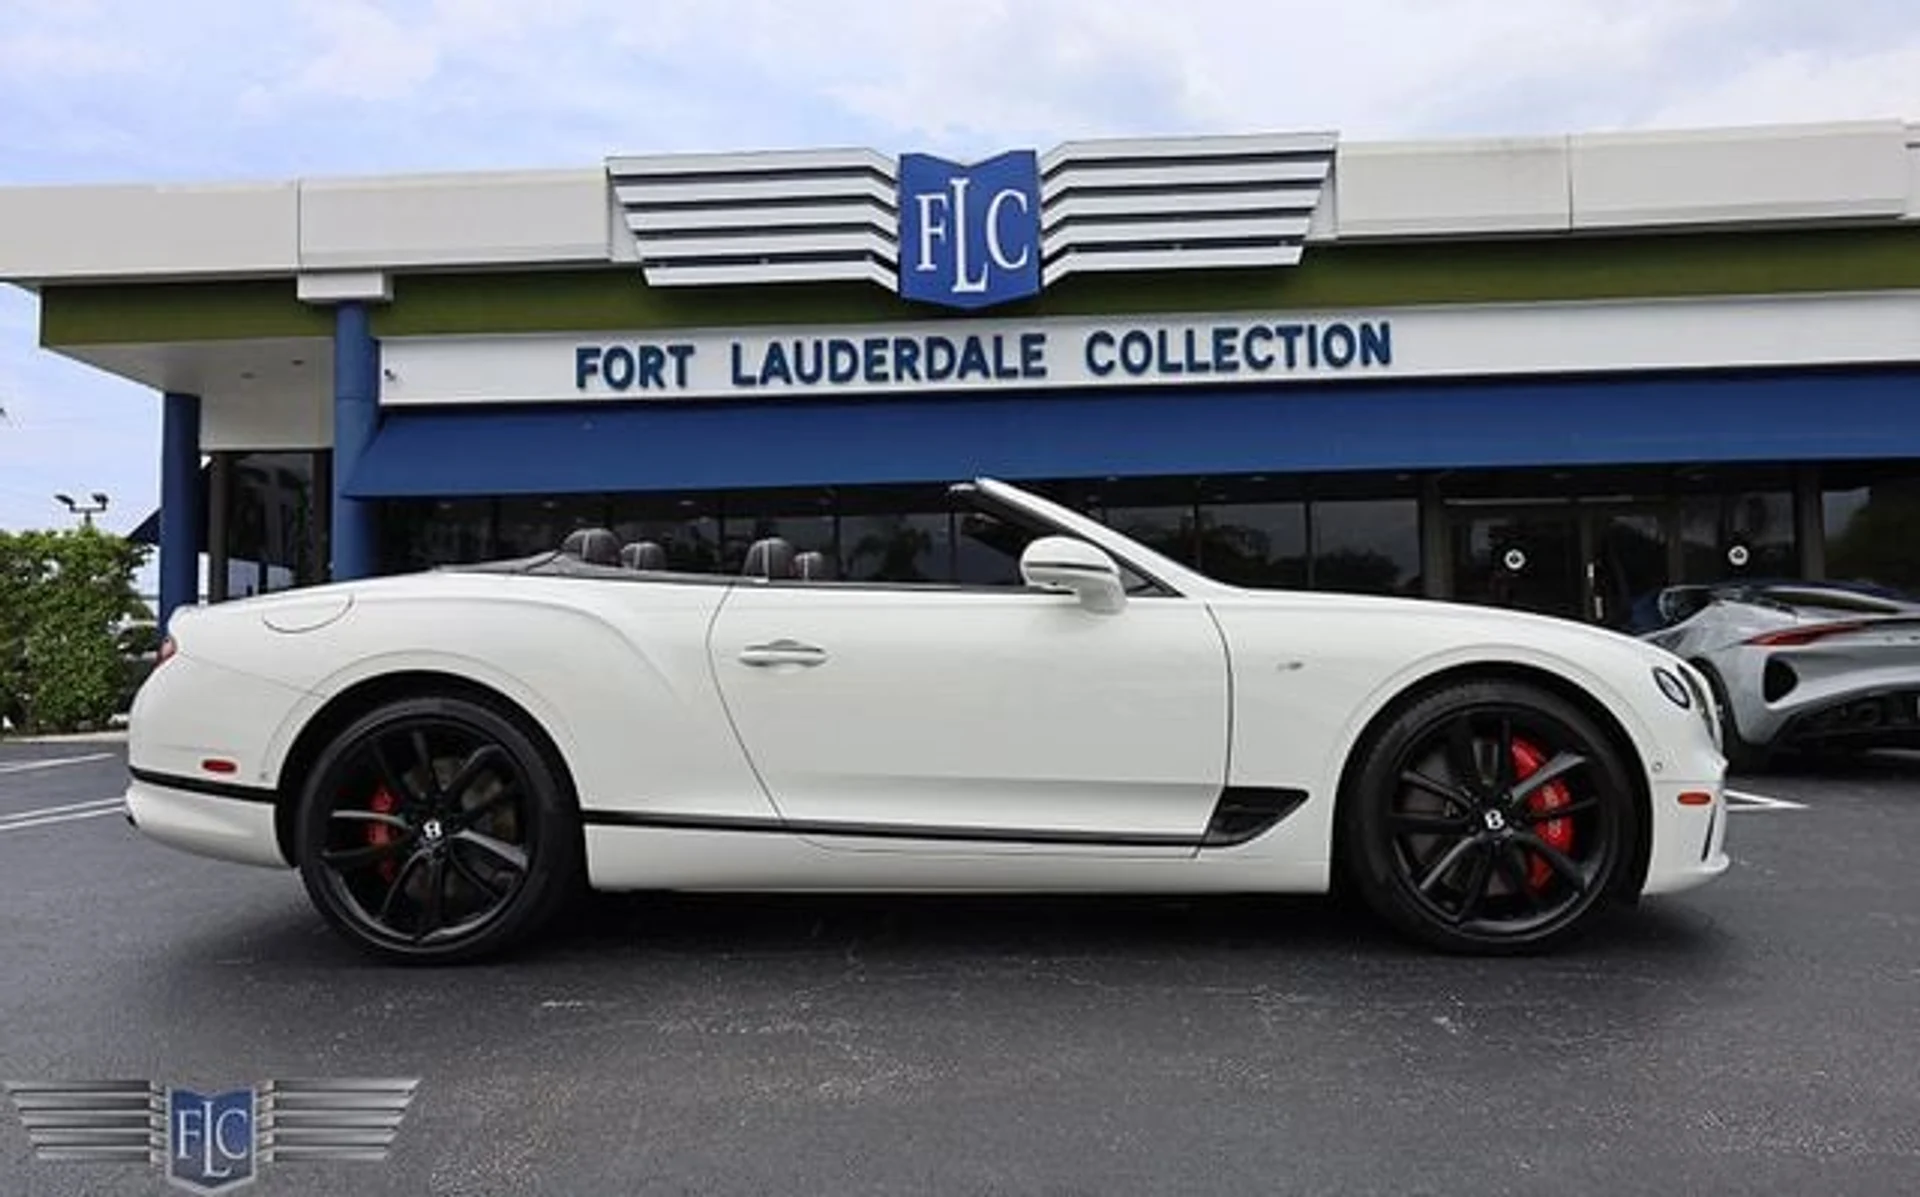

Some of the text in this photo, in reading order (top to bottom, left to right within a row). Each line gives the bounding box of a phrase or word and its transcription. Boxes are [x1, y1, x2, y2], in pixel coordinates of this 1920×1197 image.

[916, 177, 1028, 292] FLC
[575, 321, 1393, 391] FORT LAUDERDALE COLLECTION
